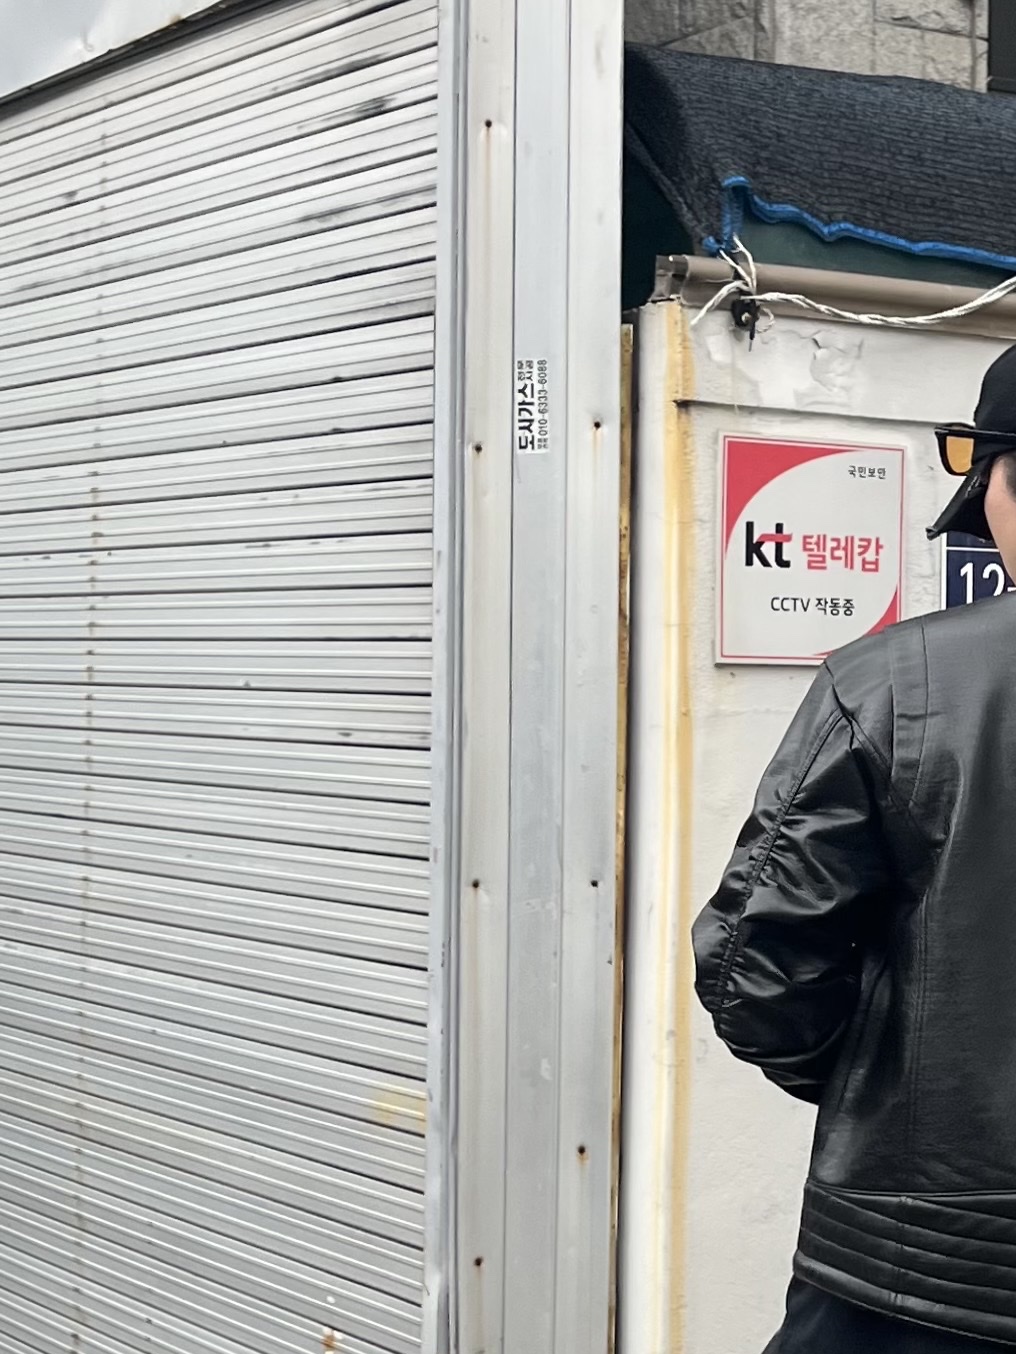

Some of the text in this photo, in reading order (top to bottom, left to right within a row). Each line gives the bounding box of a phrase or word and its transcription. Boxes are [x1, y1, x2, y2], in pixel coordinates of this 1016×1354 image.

[518, 383, 535, 450] 도시가스
[745, 521, 884, 573] kt 텔레캅
[770, 597, 855, 617] CCTV 작동중
